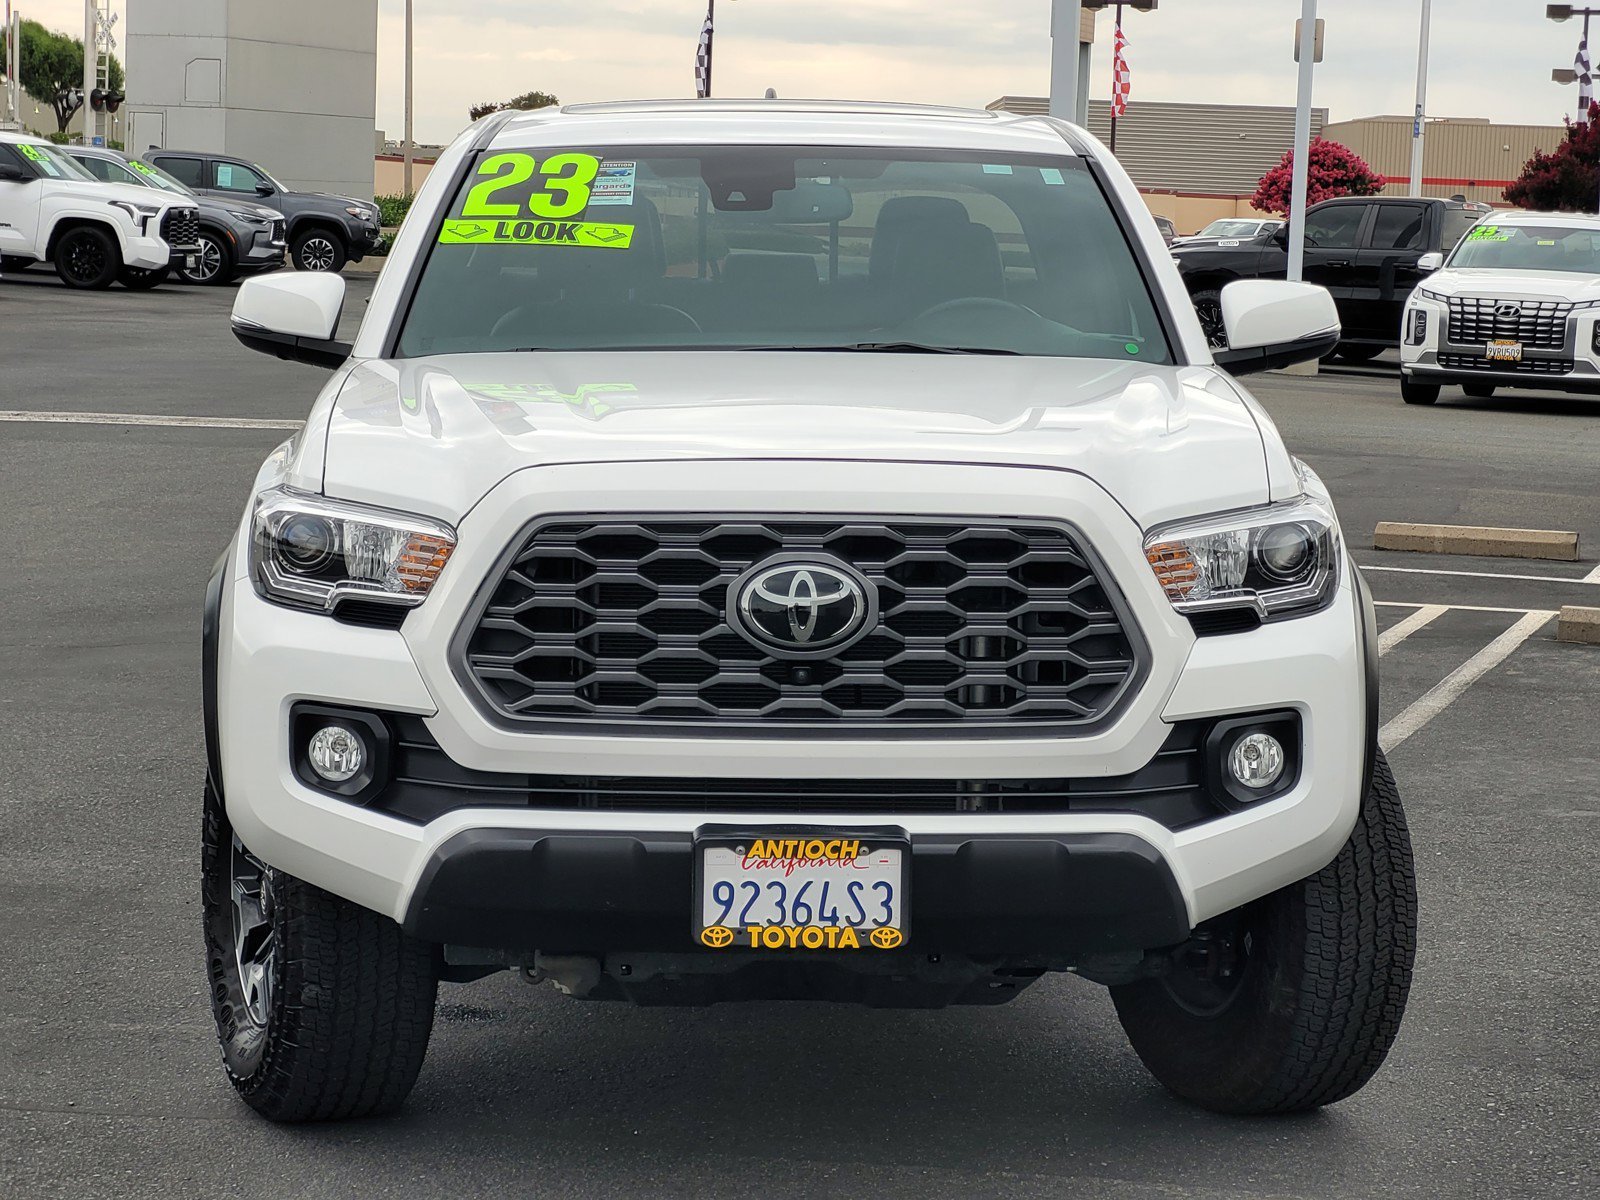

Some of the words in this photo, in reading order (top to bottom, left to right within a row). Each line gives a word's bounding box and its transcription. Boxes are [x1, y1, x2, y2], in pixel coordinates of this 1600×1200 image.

[462, 153, 599, 218] 23
[494, 221, 583, 243] LOOK
[1472, 225, 1499, 237] 23
[747, 840, 859, 859] ANTIOCH
[713, 881, 893, 926] 92364S3
[747, 926, 859, 949] TOYOTA
